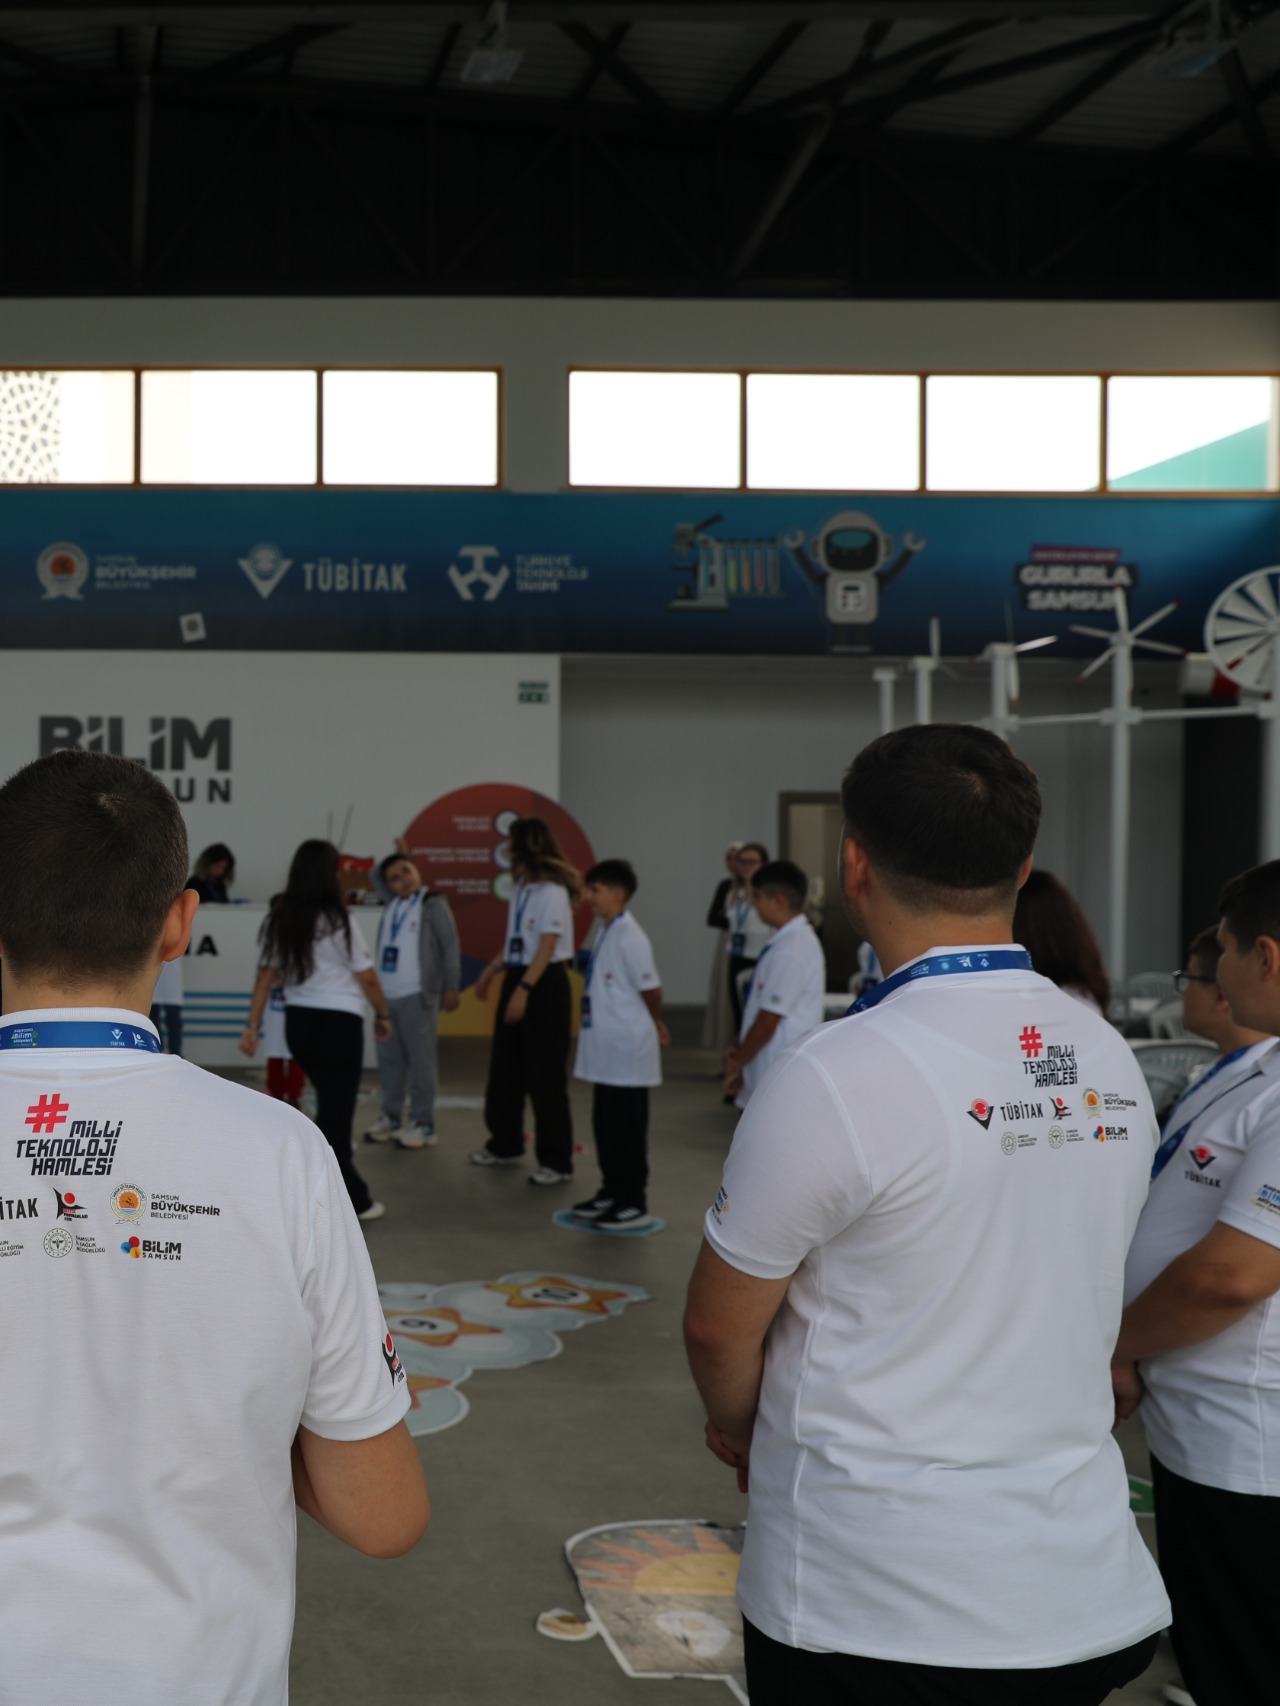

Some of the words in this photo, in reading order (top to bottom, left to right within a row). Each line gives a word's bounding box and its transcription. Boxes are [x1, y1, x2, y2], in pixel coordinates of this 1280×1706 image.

[95, 565, 196, 580] BÜYÜKŞEHİR
[303, 557, 407, 591] TÜBİTAK
[1020, 565, 1131, 586] GURURLA
[1022, 1058, 1077, 1074] TEKNOLOJİ
[1034, 1071, 1078, 1087] HAMLESİ
[1000, 1101, 1043, 1121] TÜBİTAK
[17, 1139, 118, 1158] TEKNOLOJİ
[31, 1158, 114, 1176] HAMLESİ
[1184, 1170, 1221, 1188] TÜBİTAK
[151, 1201, 220, 1216] BÜYÜKŞEHİR
[151, 1212, 189, 1220] BELEDİYESİ
[142, 1240, 181, 1254] BİLİM
[142, 1252, 181, 1261] SAMSUN
